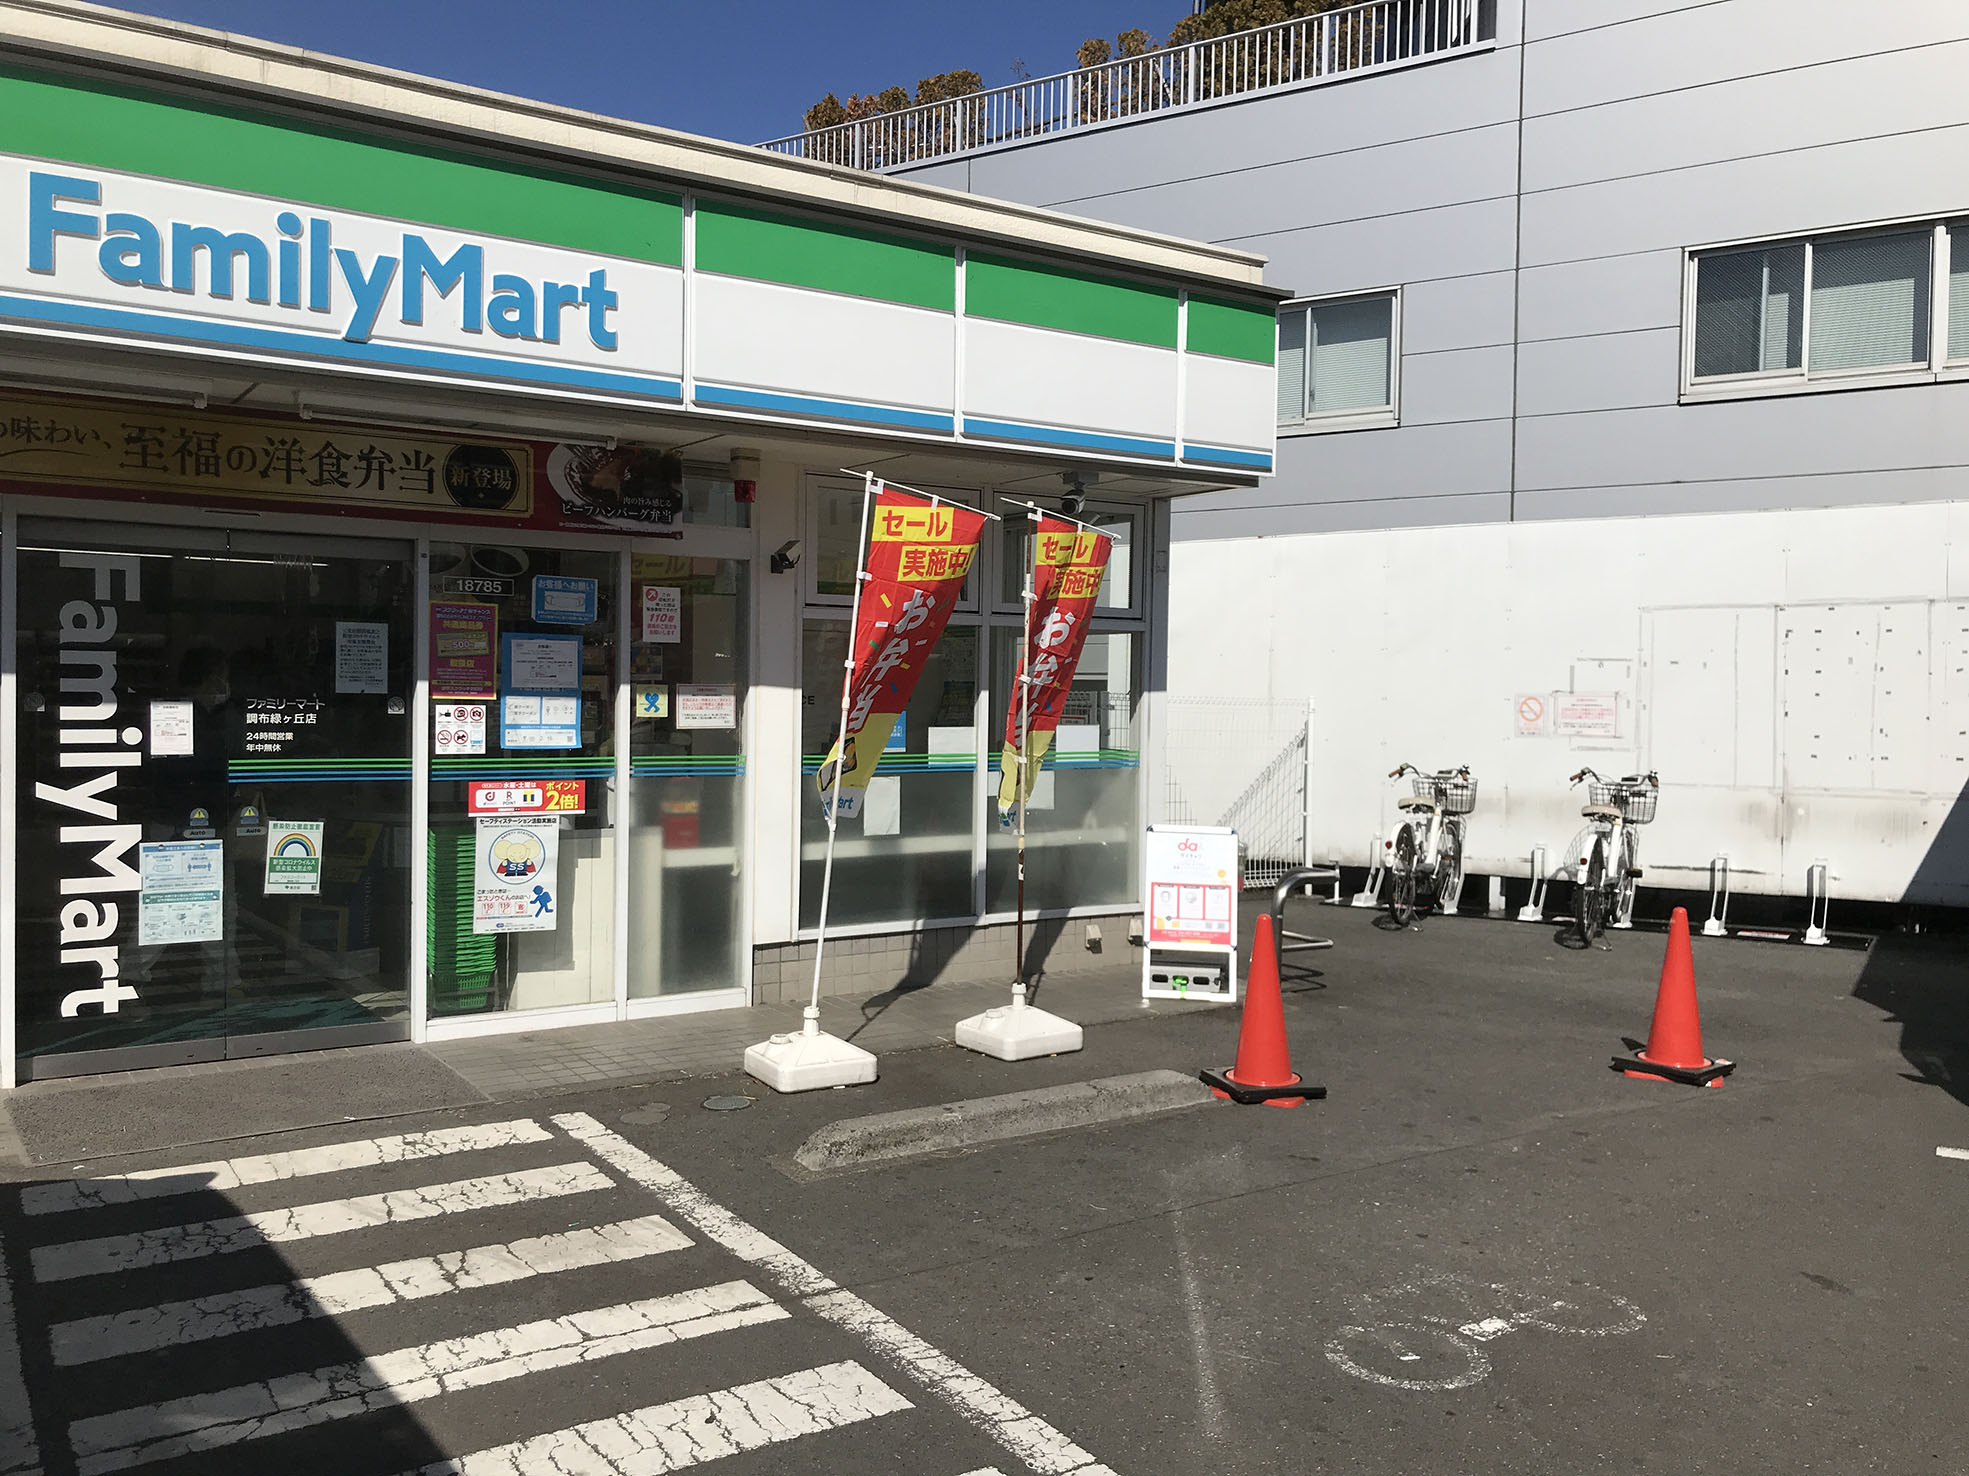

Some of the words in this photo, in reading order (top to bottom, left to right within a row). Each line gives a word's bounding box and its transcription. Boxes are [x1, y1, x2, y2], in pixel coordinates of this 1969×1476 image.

[28, 171, 618, 351] FamilyMart
[119, 422, 436, 494] 至福の洋食弁当
[450, 465, 512, 491] 新登場
[561, 501, 672, 523] ビーフハンバーグ弁当
[882, 509, 948, 537] セール
[1042, 536, 1089, 560] セール
[902, 547, 976, 577] 実施中!
[456, 579, 503, 593] 18785
[847, 589, 938, 732] お弁当
[246, 698, 325, 711] ファミリーマート
[246, 732, 294, 741] 24時間営業
[246, 743, 281, 752] 年中無休
[35, 552, 143, 1018] FamilyMart
[545, 781, 580, 791] ポイント
[545, 790, 579, 810] 2倍!
[509, 863, 524, 871] SS
